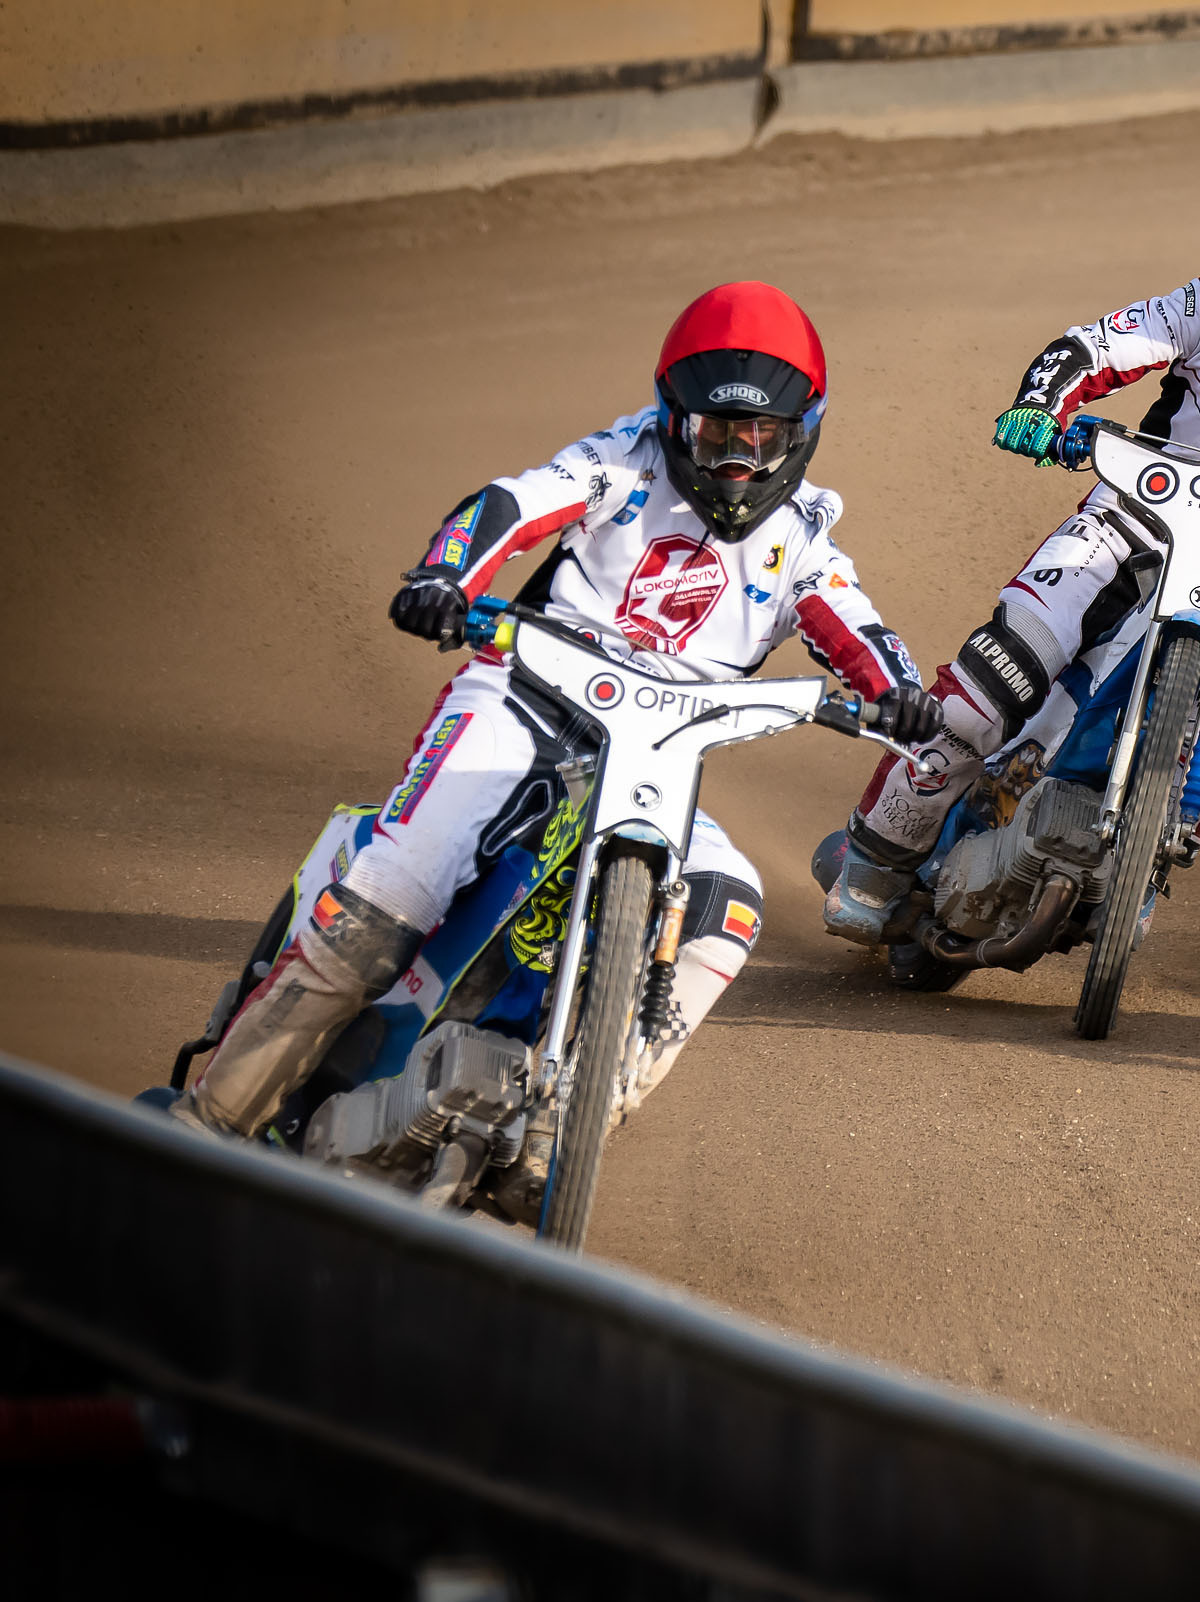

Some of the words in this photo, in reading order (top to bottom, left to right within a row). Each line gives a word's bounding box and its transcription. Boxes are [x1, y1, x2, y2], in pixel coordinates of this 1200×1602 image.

[717, 386, 762, 403] SHOEI
[634, 568, 719, 595] LOKOMOTIV
[969, 632, 1034, 702] ALPROMO
[634, 686, 744, 729] OPTIBT
[433, 718, 458, 747] LESS
